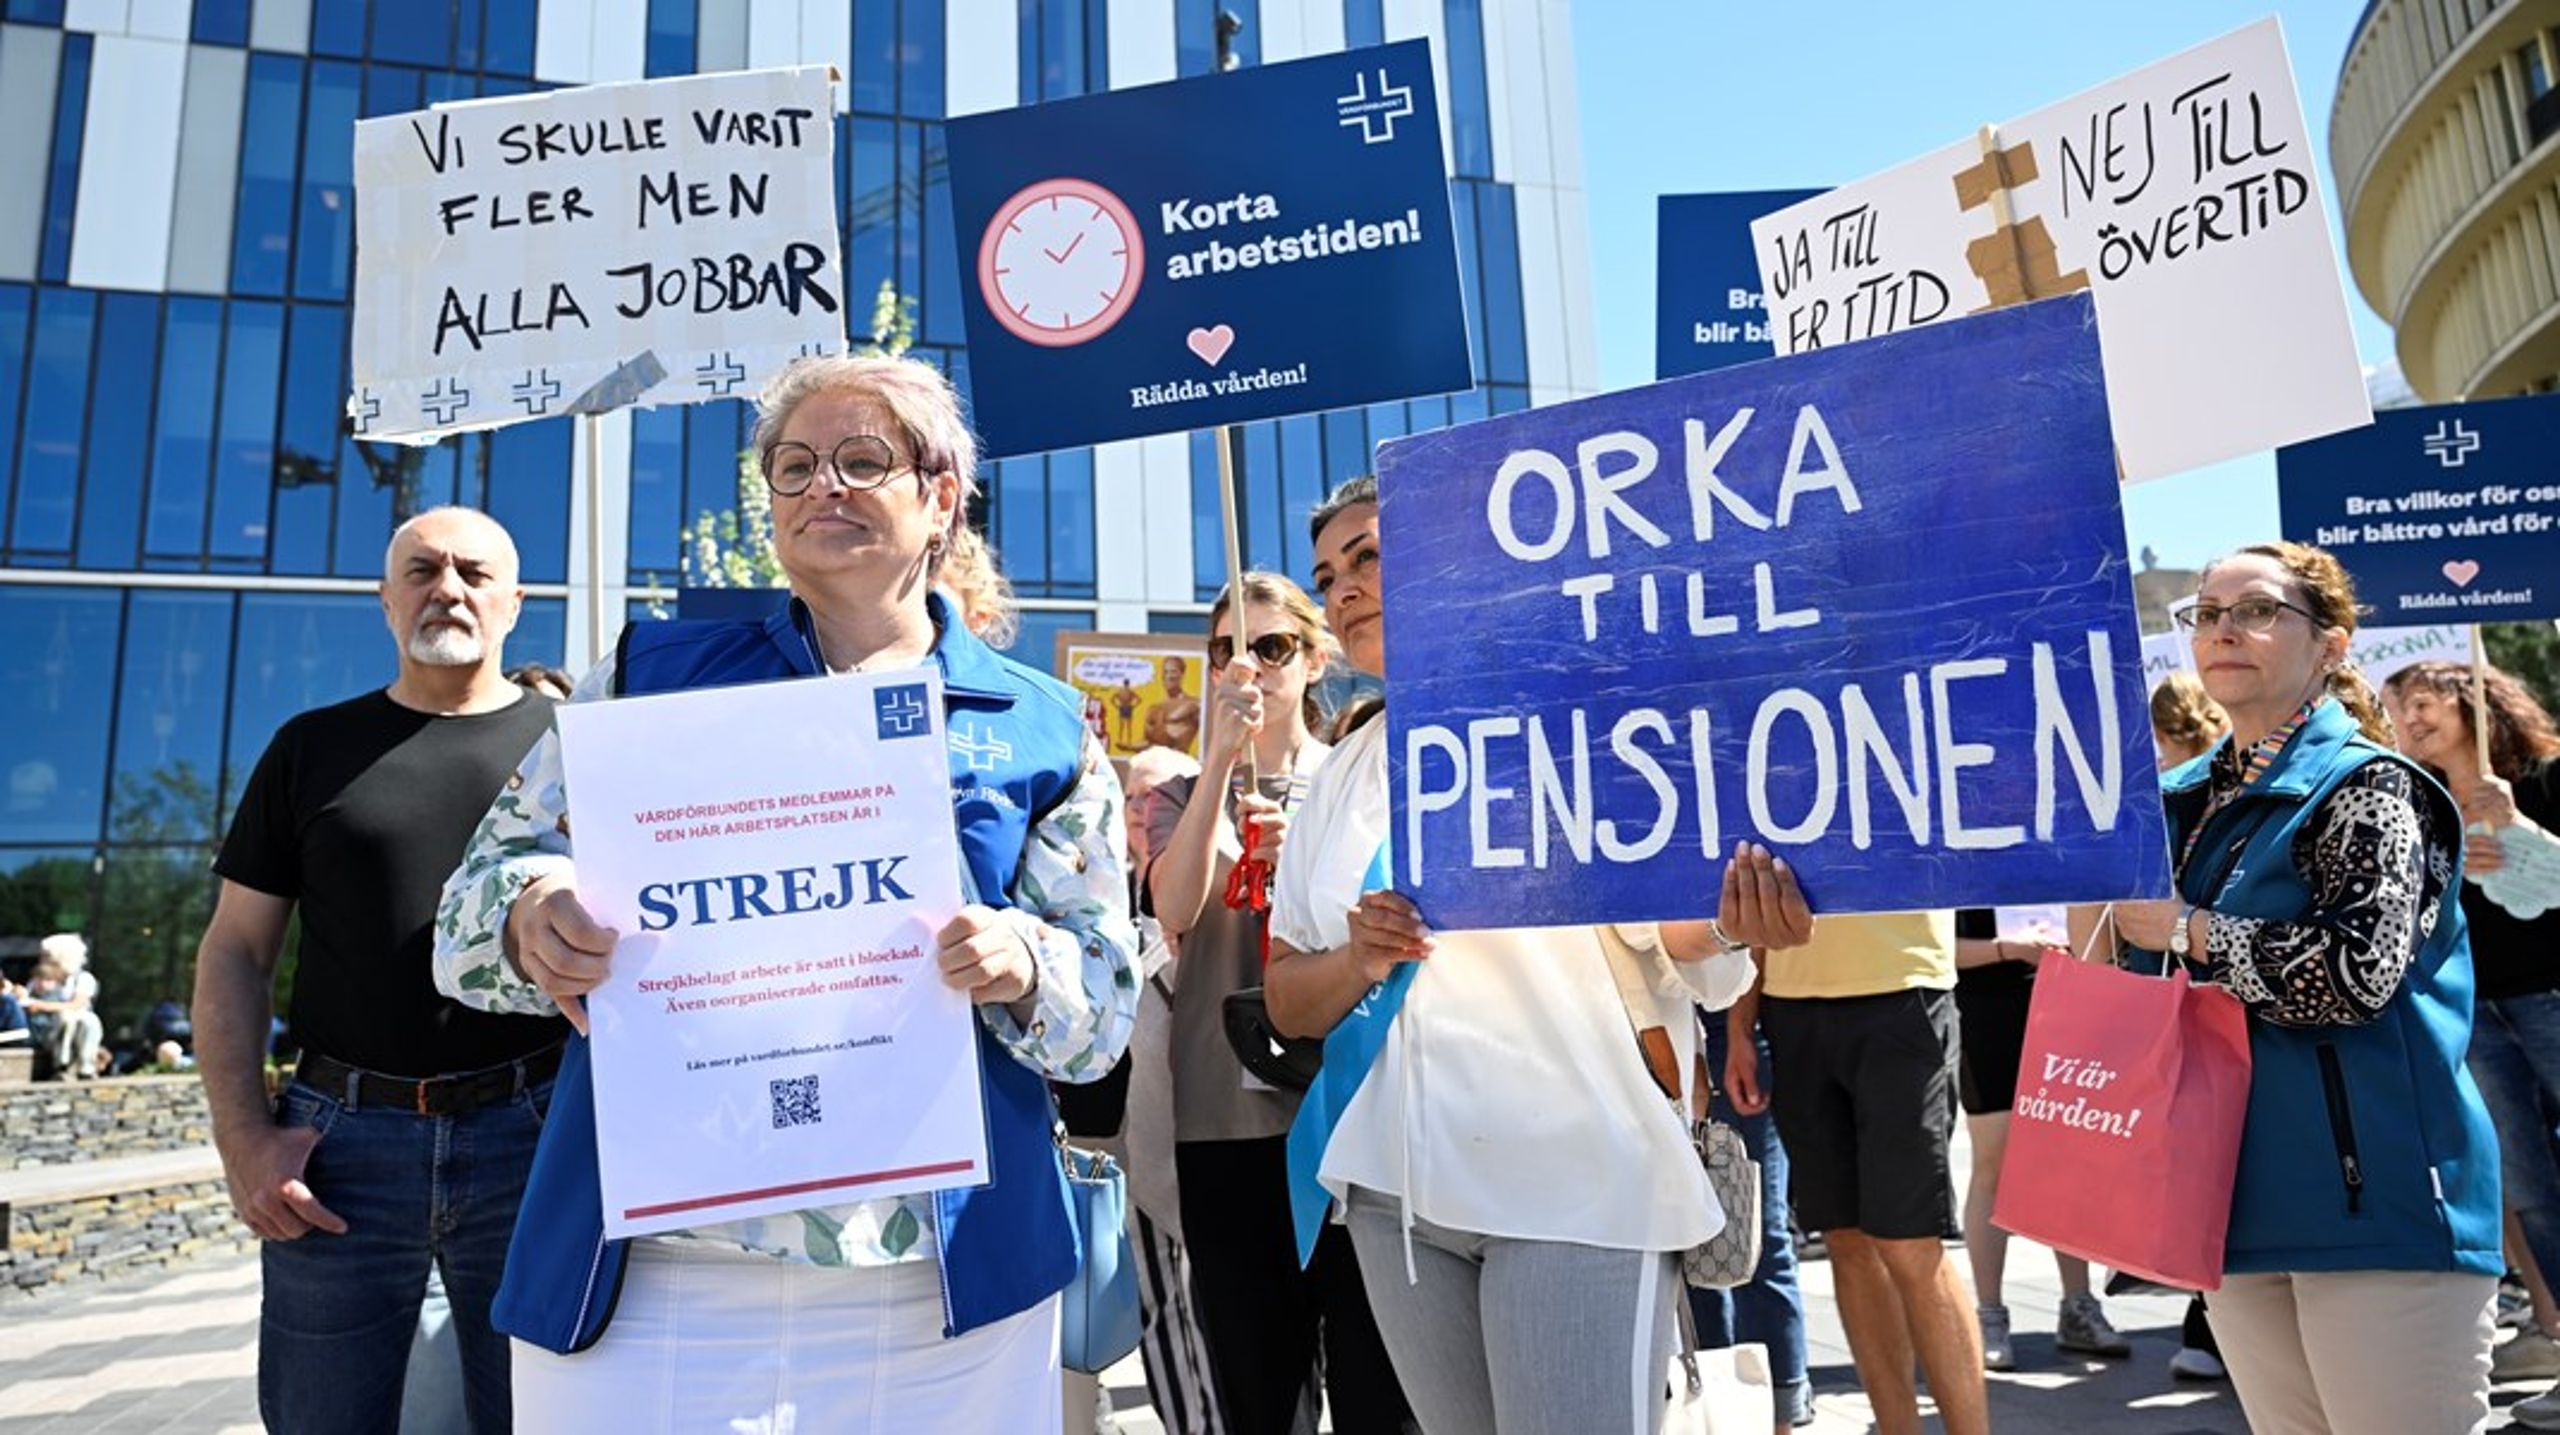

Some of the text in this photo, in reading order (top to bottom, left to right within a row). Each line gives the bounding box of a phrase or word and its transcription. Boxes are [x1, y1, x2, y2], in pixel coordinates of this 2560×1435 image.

[498, 118, 667, 165] SKULLE
[693, 108, 813, 148] VARIT
[2060, 100, 2155, 219] NEJ
[439, 171, 769, 235] FLER MEN
[1161, 191, 1280, 235] Korta
[1166, 208, 1422, 281] arbetstiden!
[1773, 228, 1812, 300] JA
[434, 242, 838, 355] ALLA JOBBAR
[1695, 321, 1741, 344] blir
[1131, 363, 1308, 409] Rädda vården!
[1487, 403, 1863, 563] ORKA
[2346, 485, 2560, 515] Bra villkor för os
[2316, 527, 2359, 546] blir
[2363, 522, 2443, 543] bättre
[2447, 515, 2508, 537] vård
[2512, 512, 2553, 533] för
[1562, 562, 1820, 641] TILL
[2399, 588, 2532, 610] Rädda vården!
[1406, 629, 2123, 888] PENSIONEN
[634, 783, 895, 825] VÅRDFÖRBUNDETS MEDLEMMAR PÅ
[655, 828, 685, 843] DEN
[689, 824, 721, 839] HÄR
[724, 809, 848, 835] ARBETSPLATSEN
[851, 806, 873, 820] ÄR
[637, 854, 915, 932] STREJK
[638, 970, 737, 993] Strejkbelagt
[740, 963, 792, 980] arbete
[795, 959, 812, 973] är
[816, 955, 845, 970] satt
[858, 945, 924, 965] blockad.
[665, 972, 903, 1013] Även oorganiserade omfattas.
[687, 1060, 706, 1071] Läs
[709, 1057, 731, 1068] mer
[734, 1053, 749, 1067] på
[2043, 1053, 2116, 1090] Vi är
[2017, 1088, 2142, 1139] vården!
